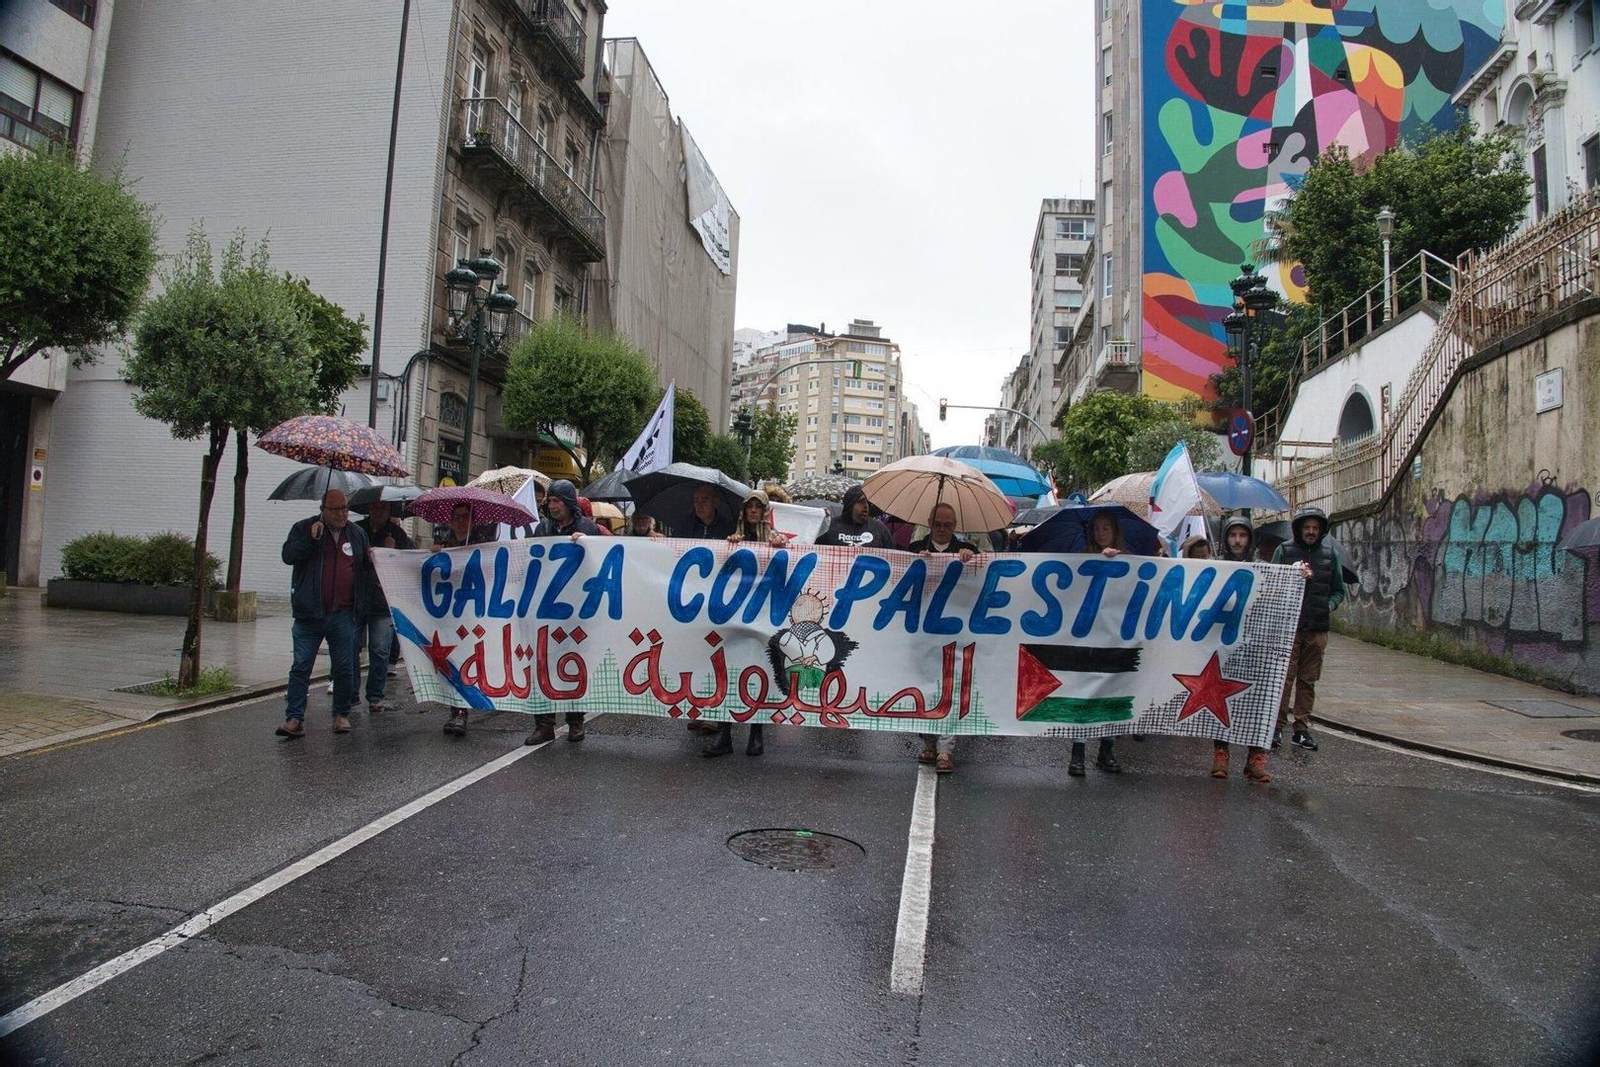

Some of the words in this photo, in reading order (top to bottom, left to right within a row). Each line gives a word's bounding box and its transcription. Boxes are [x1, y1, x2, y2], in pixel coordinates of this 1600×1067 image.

[440, 458, 460, 473] KEISHA
[666, 546, 819, 628] CON
[459, 623, 589, 701] قاتلة
[622, 627, 977, 728] الصهيونية
